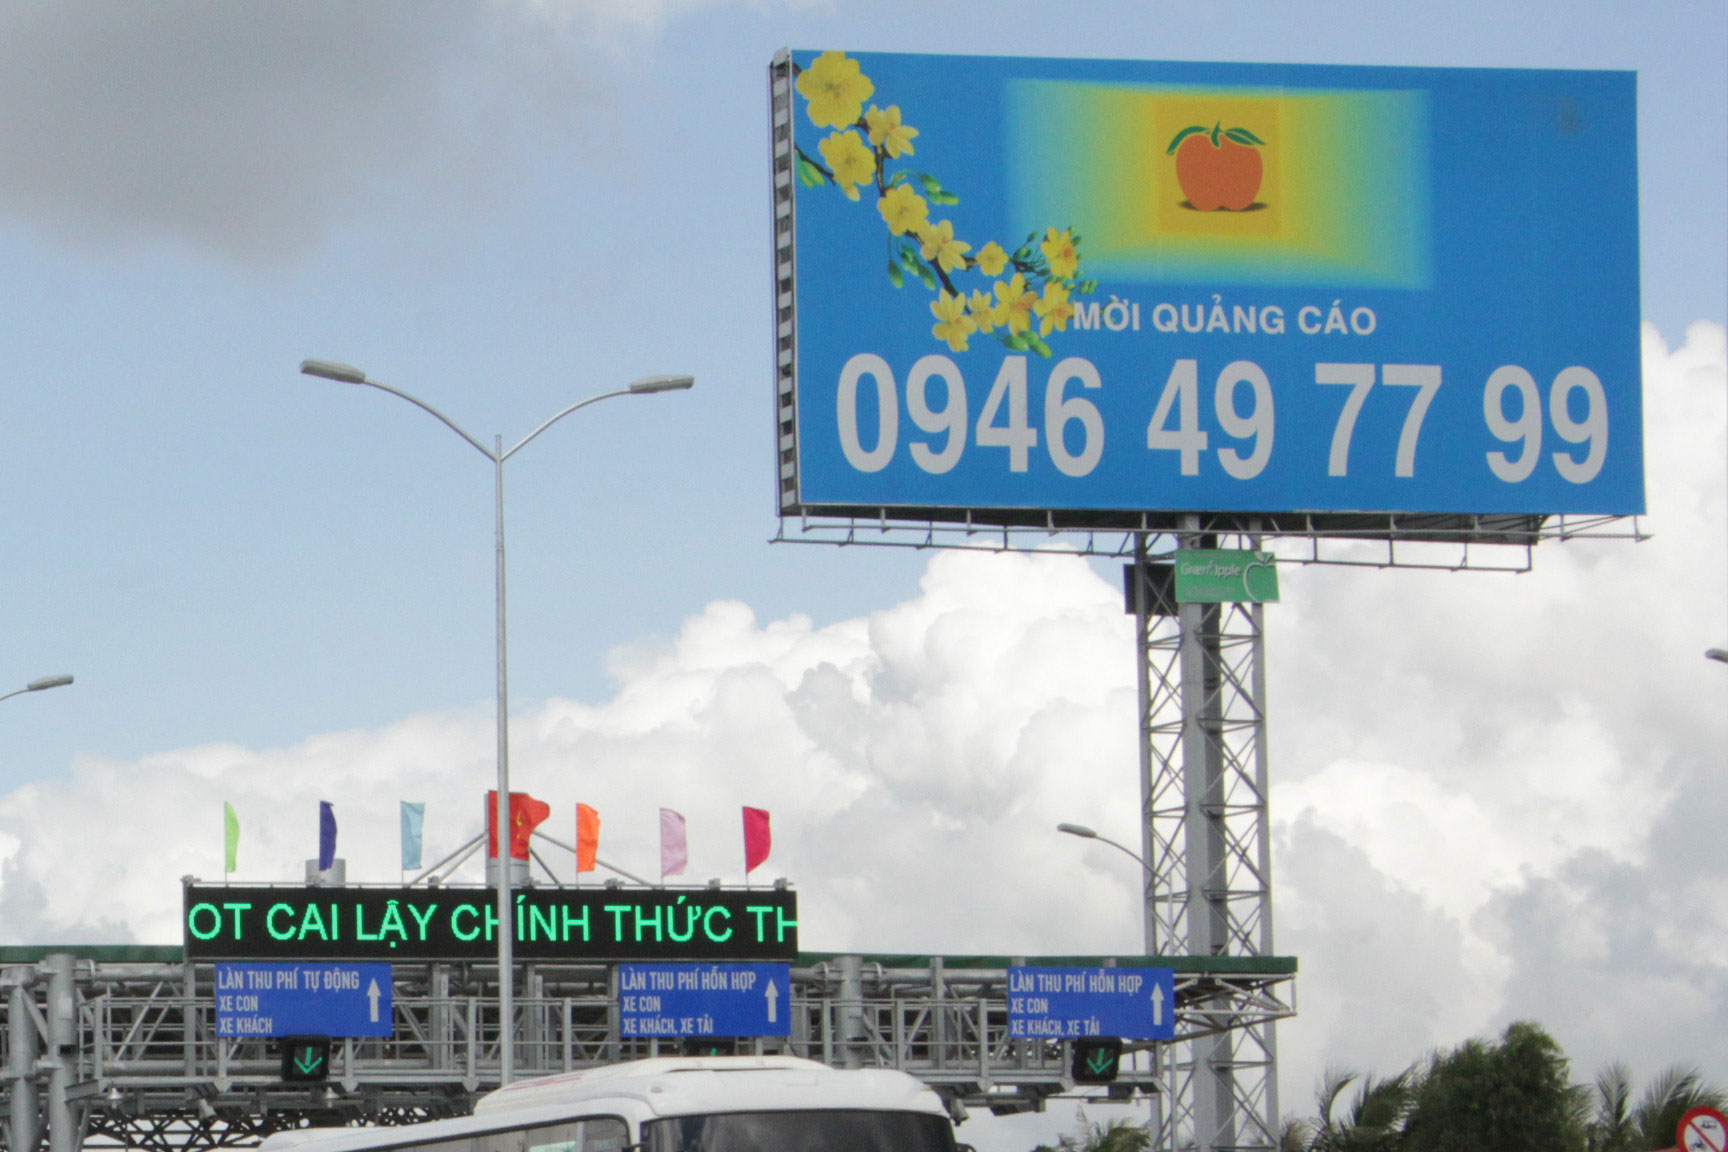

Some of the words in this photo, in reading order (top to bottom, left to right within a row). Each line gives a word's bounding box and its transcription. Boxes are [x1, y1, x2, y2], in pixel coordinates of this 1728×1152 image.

[1072, 294, 1140, 331] MỜI
[1152, 294, 1285, 334] QUẢNG
[1297, 299, 1378, 336] CÁO
[836, 353, 1105, 478] 0946
[1147, 358, 1275, 480] 49
[1315, 362, 1442, 478] 77
[1483, 364, 1609, 484] 99
[188, 902, 252, 940] OT
[266, 902, 339, 941] CAI
[356, 899, 438, 948] LẬY
[450, 894, 590, 941] CHÍNH
[604, 895, 733, 942] THỨC
[218, 966, 244, 990] LÀN
[247, 971, 272, 989] THU
[276, 966, 298, 989] PHÍ
[303, 971, 320, 993] TỰ
[323, 967, 360, 993] ĐỘNG
[622, 967, 646, 990] LÀN
[649, 972, 674, 990] THU
[677, 967, 698, 990] PHÍ
[702, 965, 728, 990] HỖN
[731, 971, 756, 993] HỢP
[1010, 970, 1034, 992] LÀN
[1037, 974, 1062, 992] THU
[1065, 970, 1087, 993] PHÍ
[1089, 969, 1115, 993] HỖN
[1118, 974, 1143, 996] HỢP
[219, 995, 234, 1011] XE
[236, 995, 258, 1012] CON
[623, 996, 637, 1012] XE
[639, 996, 661, 1012] CON
[1011, 998, 1024, 1013] XE
[1027, 998, 1048, 1014] CON
[219, 1017, 234, 1034] XE
[236, 1013, 272, 1034] KHÁCH
[623, 1017, 637, 1034] XE
[680, 1017, 694, 1034] XE
[697, 1013, 713, 1034] TẢI
[1011, 1019, 1024, 1035] XE
[1067, 1020, 1080, 1036] XE
[1084, 1016, 1100, 1036] TẢI
